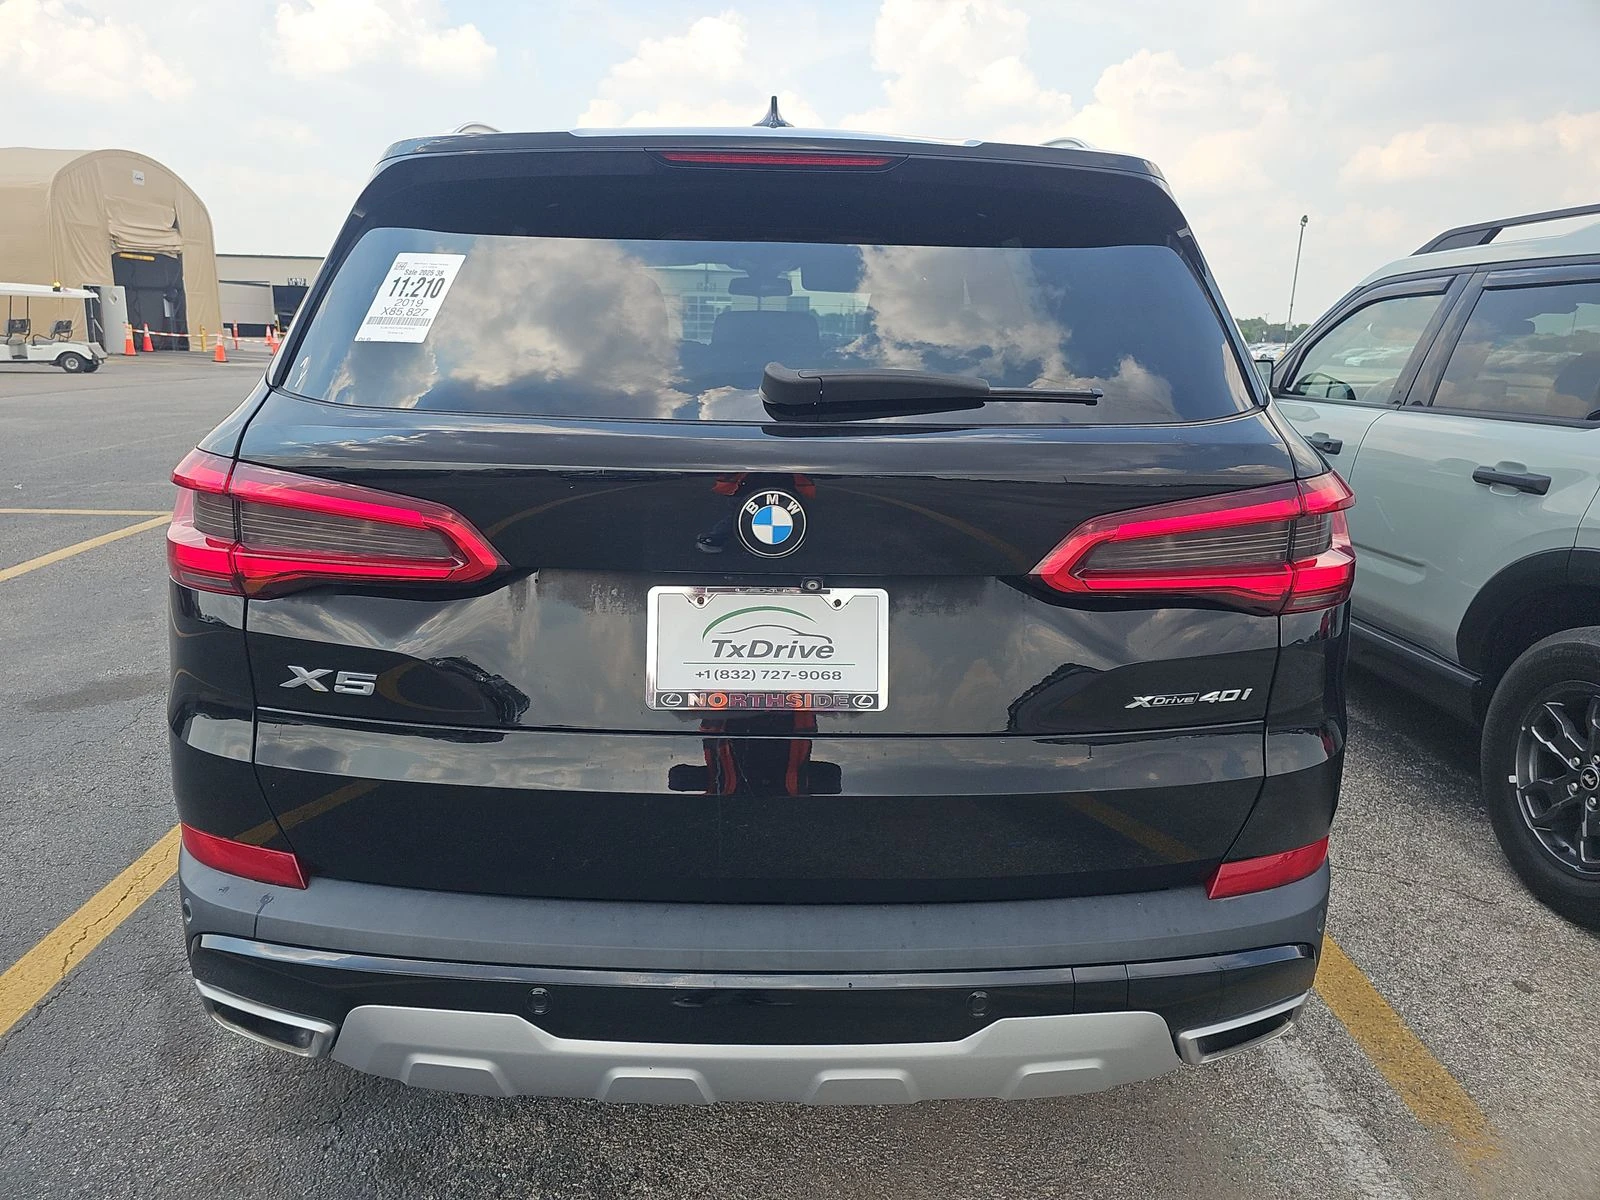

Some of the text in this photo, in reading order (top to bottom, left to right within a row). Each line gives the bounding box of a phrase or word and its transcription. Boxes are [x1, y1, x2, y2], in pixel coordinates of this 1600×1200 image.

[388, 276, 446, 299] 11:210
[394, 299, 424, 308] 2019
[745, 494, 801, 516] BMW
[711, 639, 835, 660] TxDrive
[279, 665, 378, 696] X5
[760, 670, 843, 681] 727-9068
[687, 692, 850, 709] NORTHSIDE
